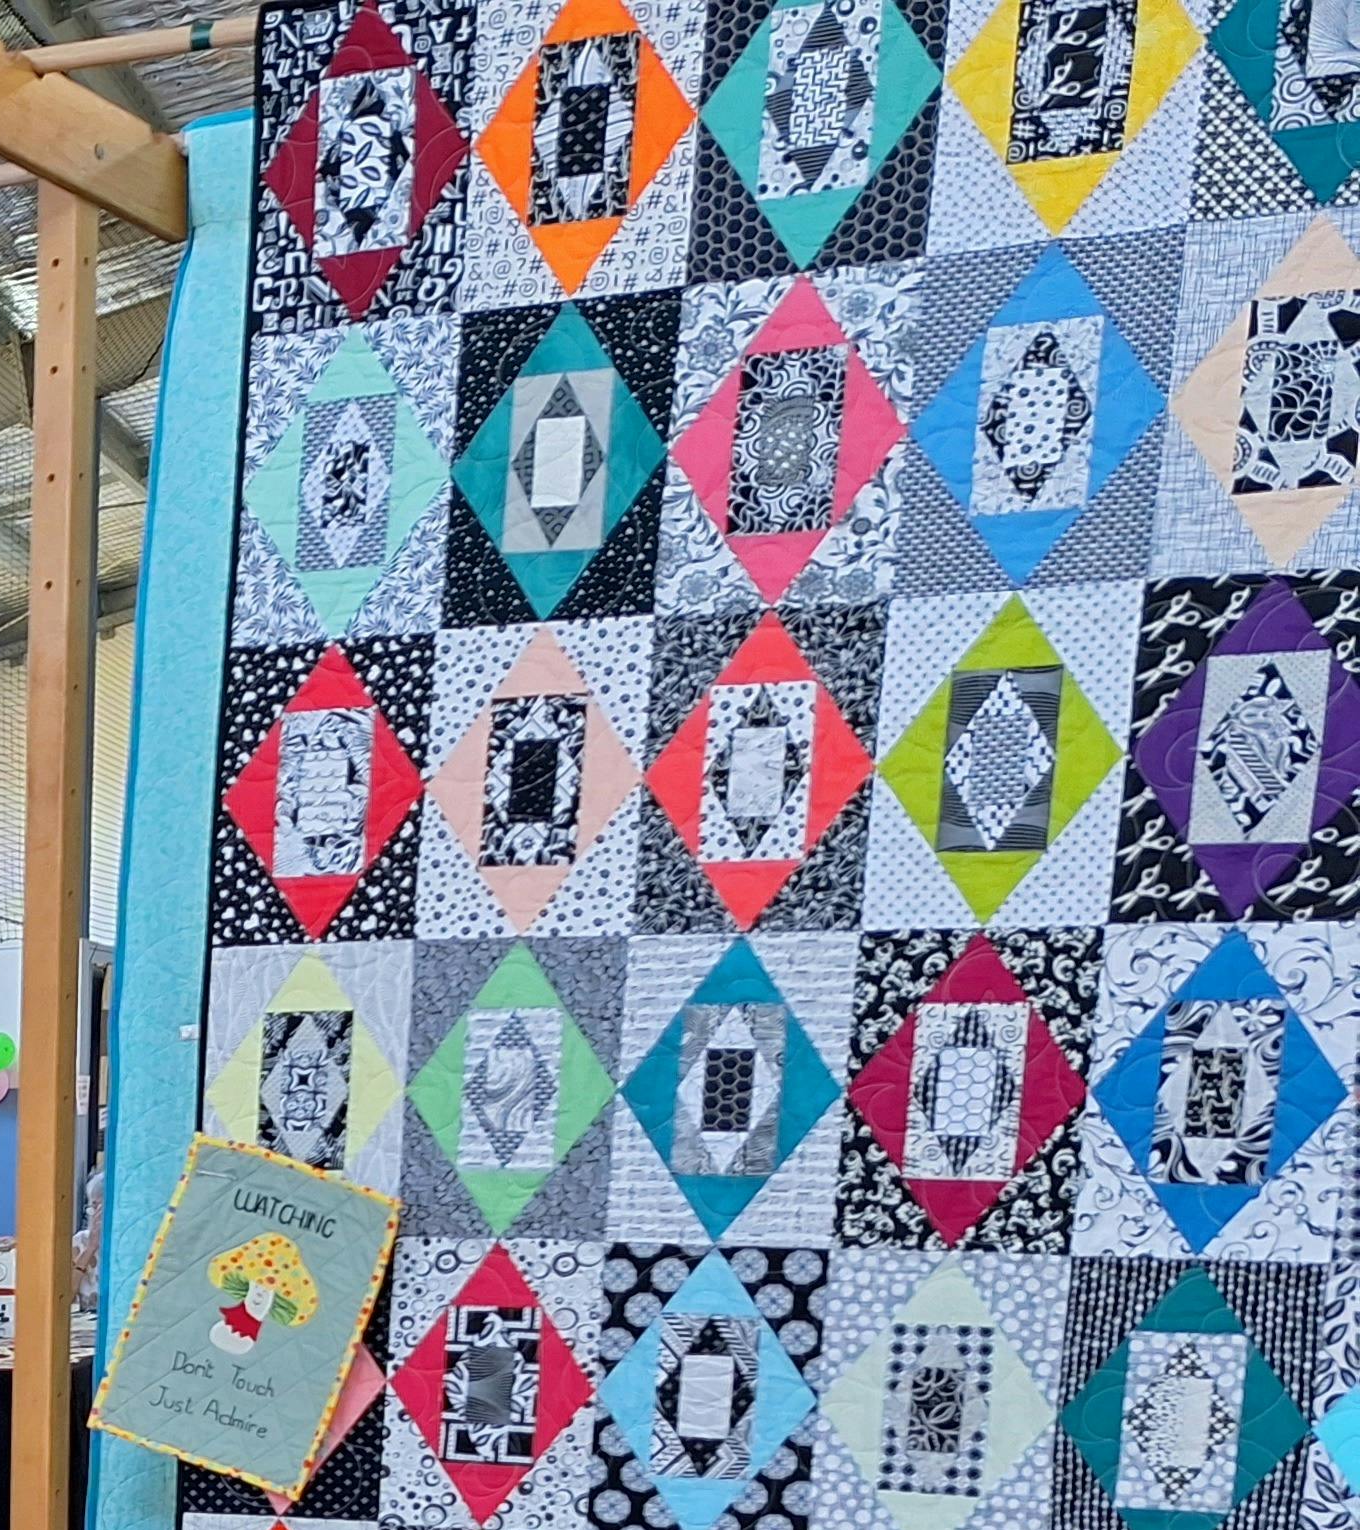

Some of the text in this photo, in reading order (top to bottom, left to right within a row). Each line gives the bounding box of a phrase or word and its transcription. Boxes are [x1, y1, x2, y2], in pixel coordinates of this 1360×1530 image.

[172, 1350, 275, 1398] Don't Touch
[148, 1385, 268, 1439] Just Admire
